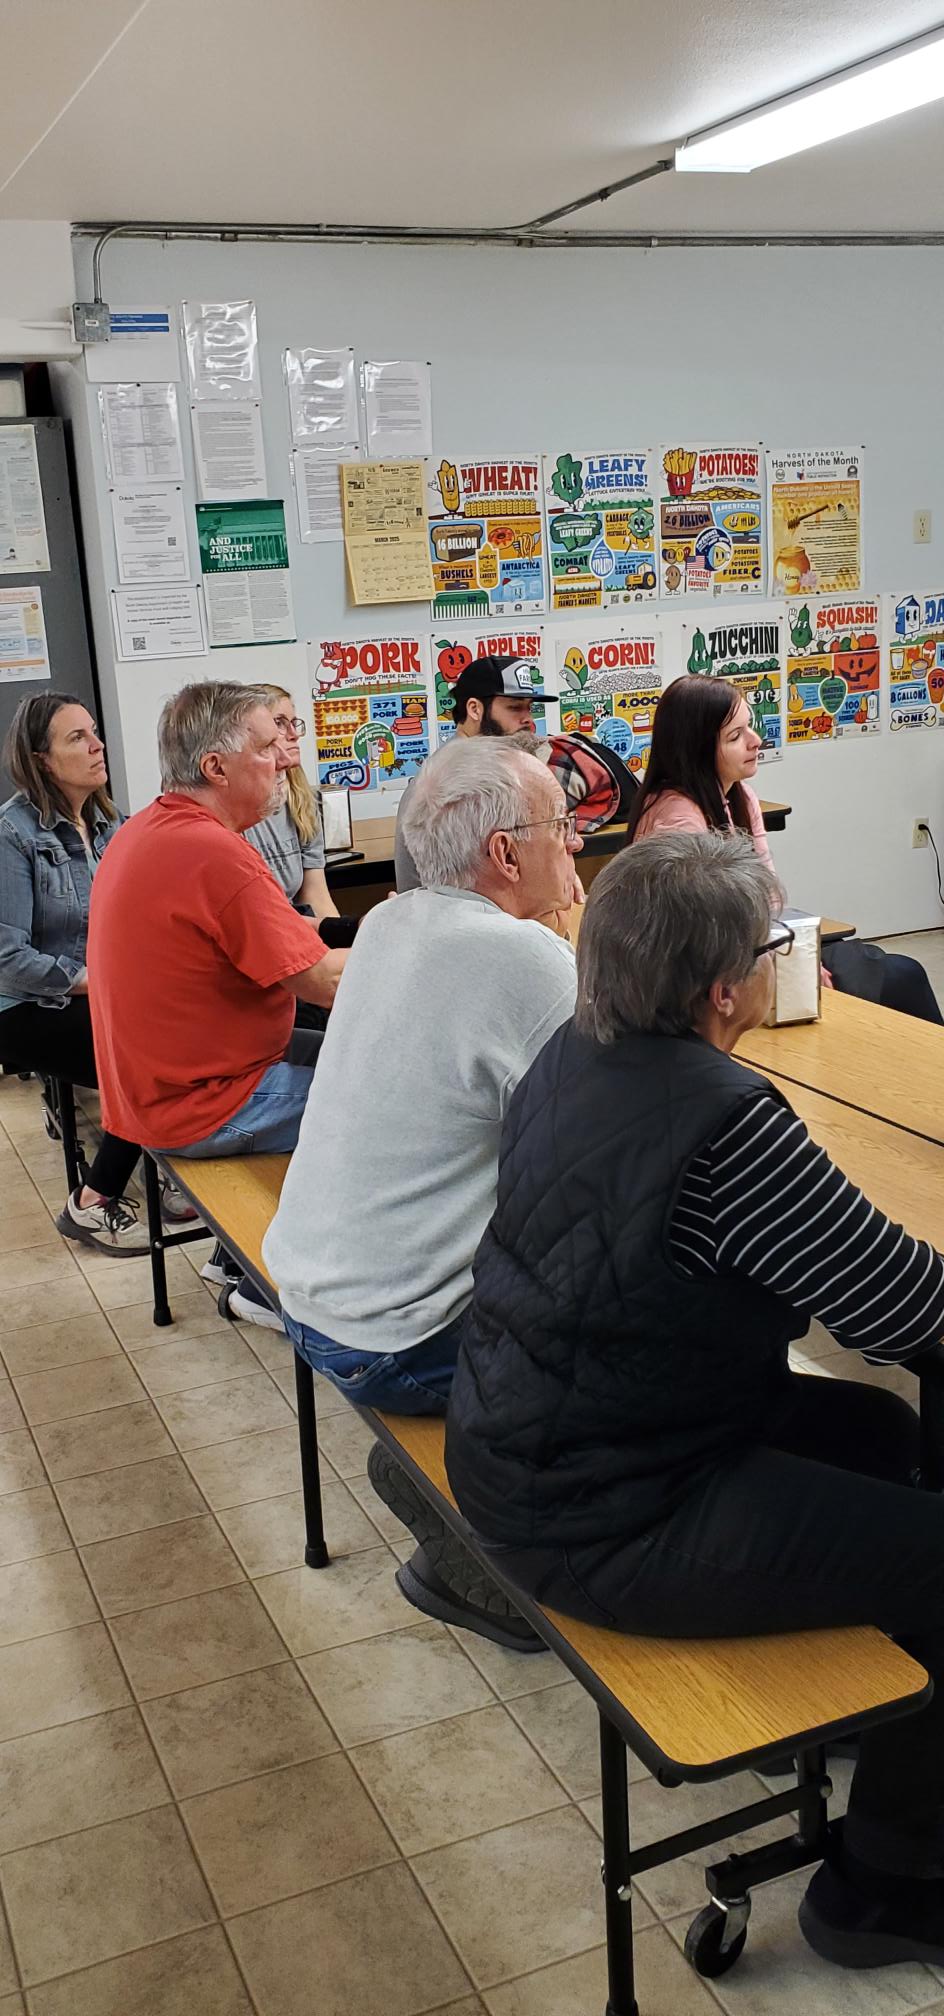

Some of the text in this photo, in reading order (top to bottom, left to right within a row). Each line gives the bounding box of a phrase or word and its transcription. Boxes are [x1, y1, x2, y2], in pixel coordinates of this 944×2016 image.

[588, 459, 646, 474] LEAFY
[699, 453, 758, 478] POTATOES!
[772, 459, 805, 468] Harvest
[807, 458, 815, 466] of
[833, 456, 859, 465] Month
[461, 466, 538, 494] WHEAT!
[585, 474, 648, 491] GREENS!
[716, 503, 760, 512] AMERICANS
[680, 514, 711, 527] BILLION
[209, 537, 231, 546] AND
[437, 537, 478, 550] 16 BILLION
[209, 544, 253, 554] JUSTICE
[222, 553, 242, 562] ALL
[554, 556, 588, 568] COMBAT
[502, 561, 540, 571] ANTARCTICA
[440, 568, 474, 579] BUSHELS
[752, 566, 761, 579] C
[785, 573, 799, 583] Honey
[816, 606, 878, 631] SQUASH!
[477, 636, 541, 659] APPLES!
[709, 626, 779, 660] ZUCCHINI
[340, 642, 421, 678] PORK
[588, 643, 655, 670] CORN!
[932, 677, 944, 689] 50
[890, 688, 927, 703] 8 GALLONS
[845, 700, 859, 709] 100
[372, 711, 398, 719] PORK
[898, 713, 929, 724] BONES
[789, 730, 808, 738] FRUIT
[318, 746, 352, 760] MUSCLES
[614, 742, 627, 752] 48
[329, 761, 354, 769] PIGS
